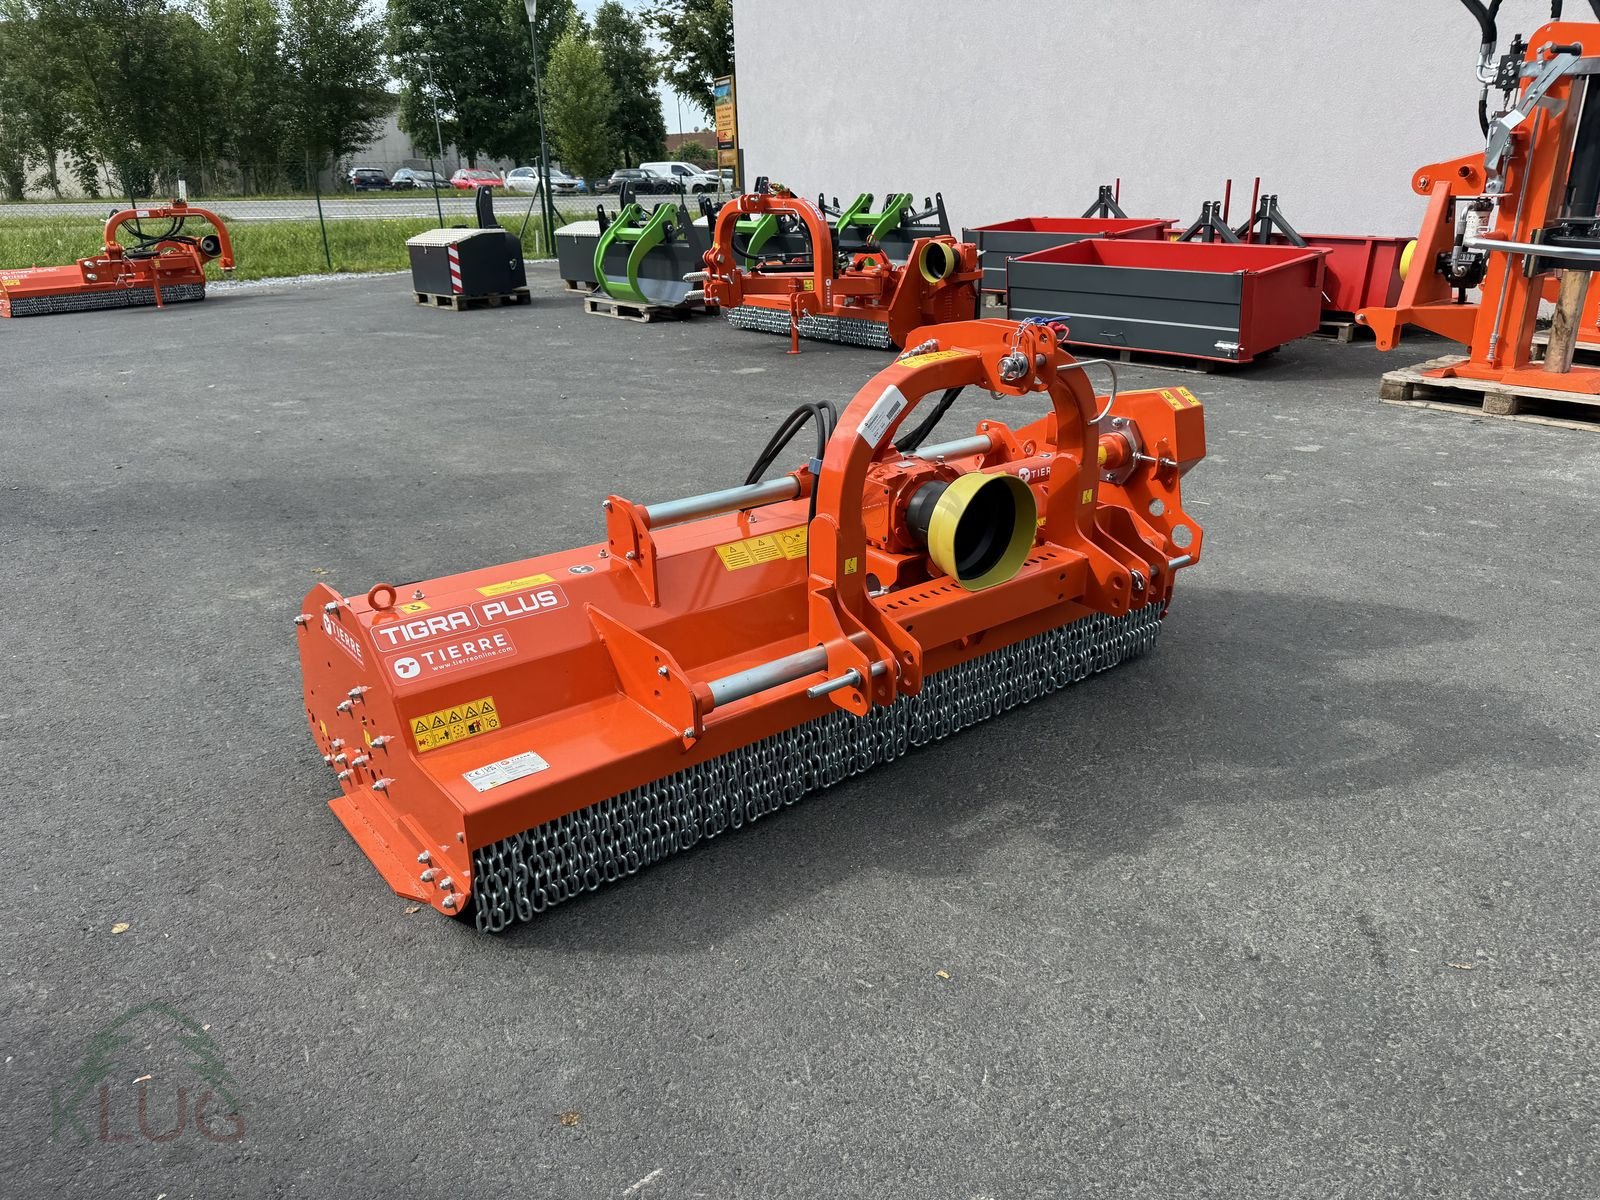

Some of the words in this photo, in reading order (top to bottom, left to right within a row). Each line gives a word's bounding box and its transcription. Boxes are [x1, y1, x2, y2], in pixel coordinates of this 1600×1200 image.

[379, 611, 472, 645] TIGRA
[481, 590, 558, 621] PLUS
[331, 620, 362, 658] TIERRE
[421, 633, 508, 665] TIERRE
[432, 646, 513, 672] www.tierreonline.com
